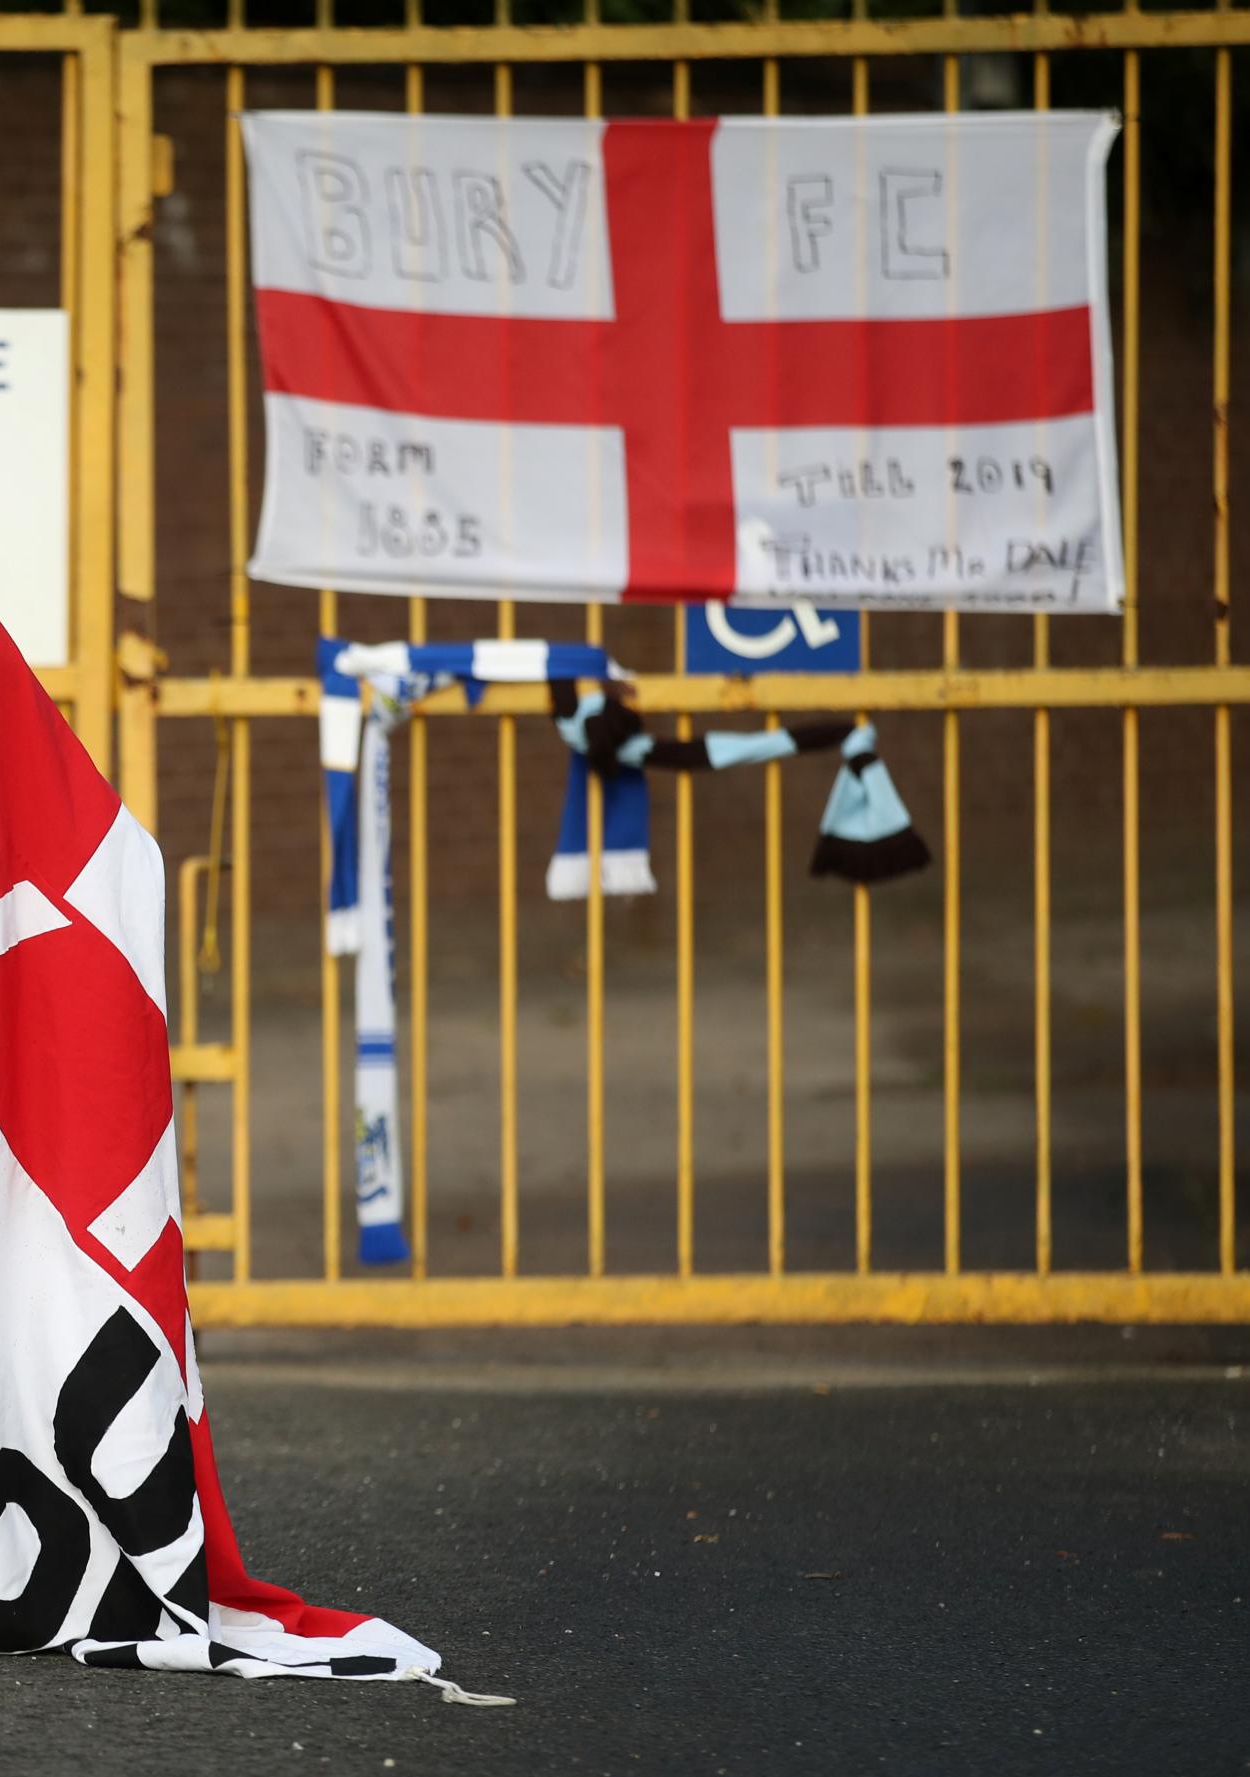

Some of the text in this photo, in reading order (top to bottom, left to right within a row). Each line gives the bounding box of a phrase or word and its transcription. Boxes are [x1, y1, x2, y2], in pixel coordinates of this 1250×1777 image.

[294, 148, 592, 290] BURY
[303, 426, 436, 479] FORM
[947, 455, 1055, 497] 2019
